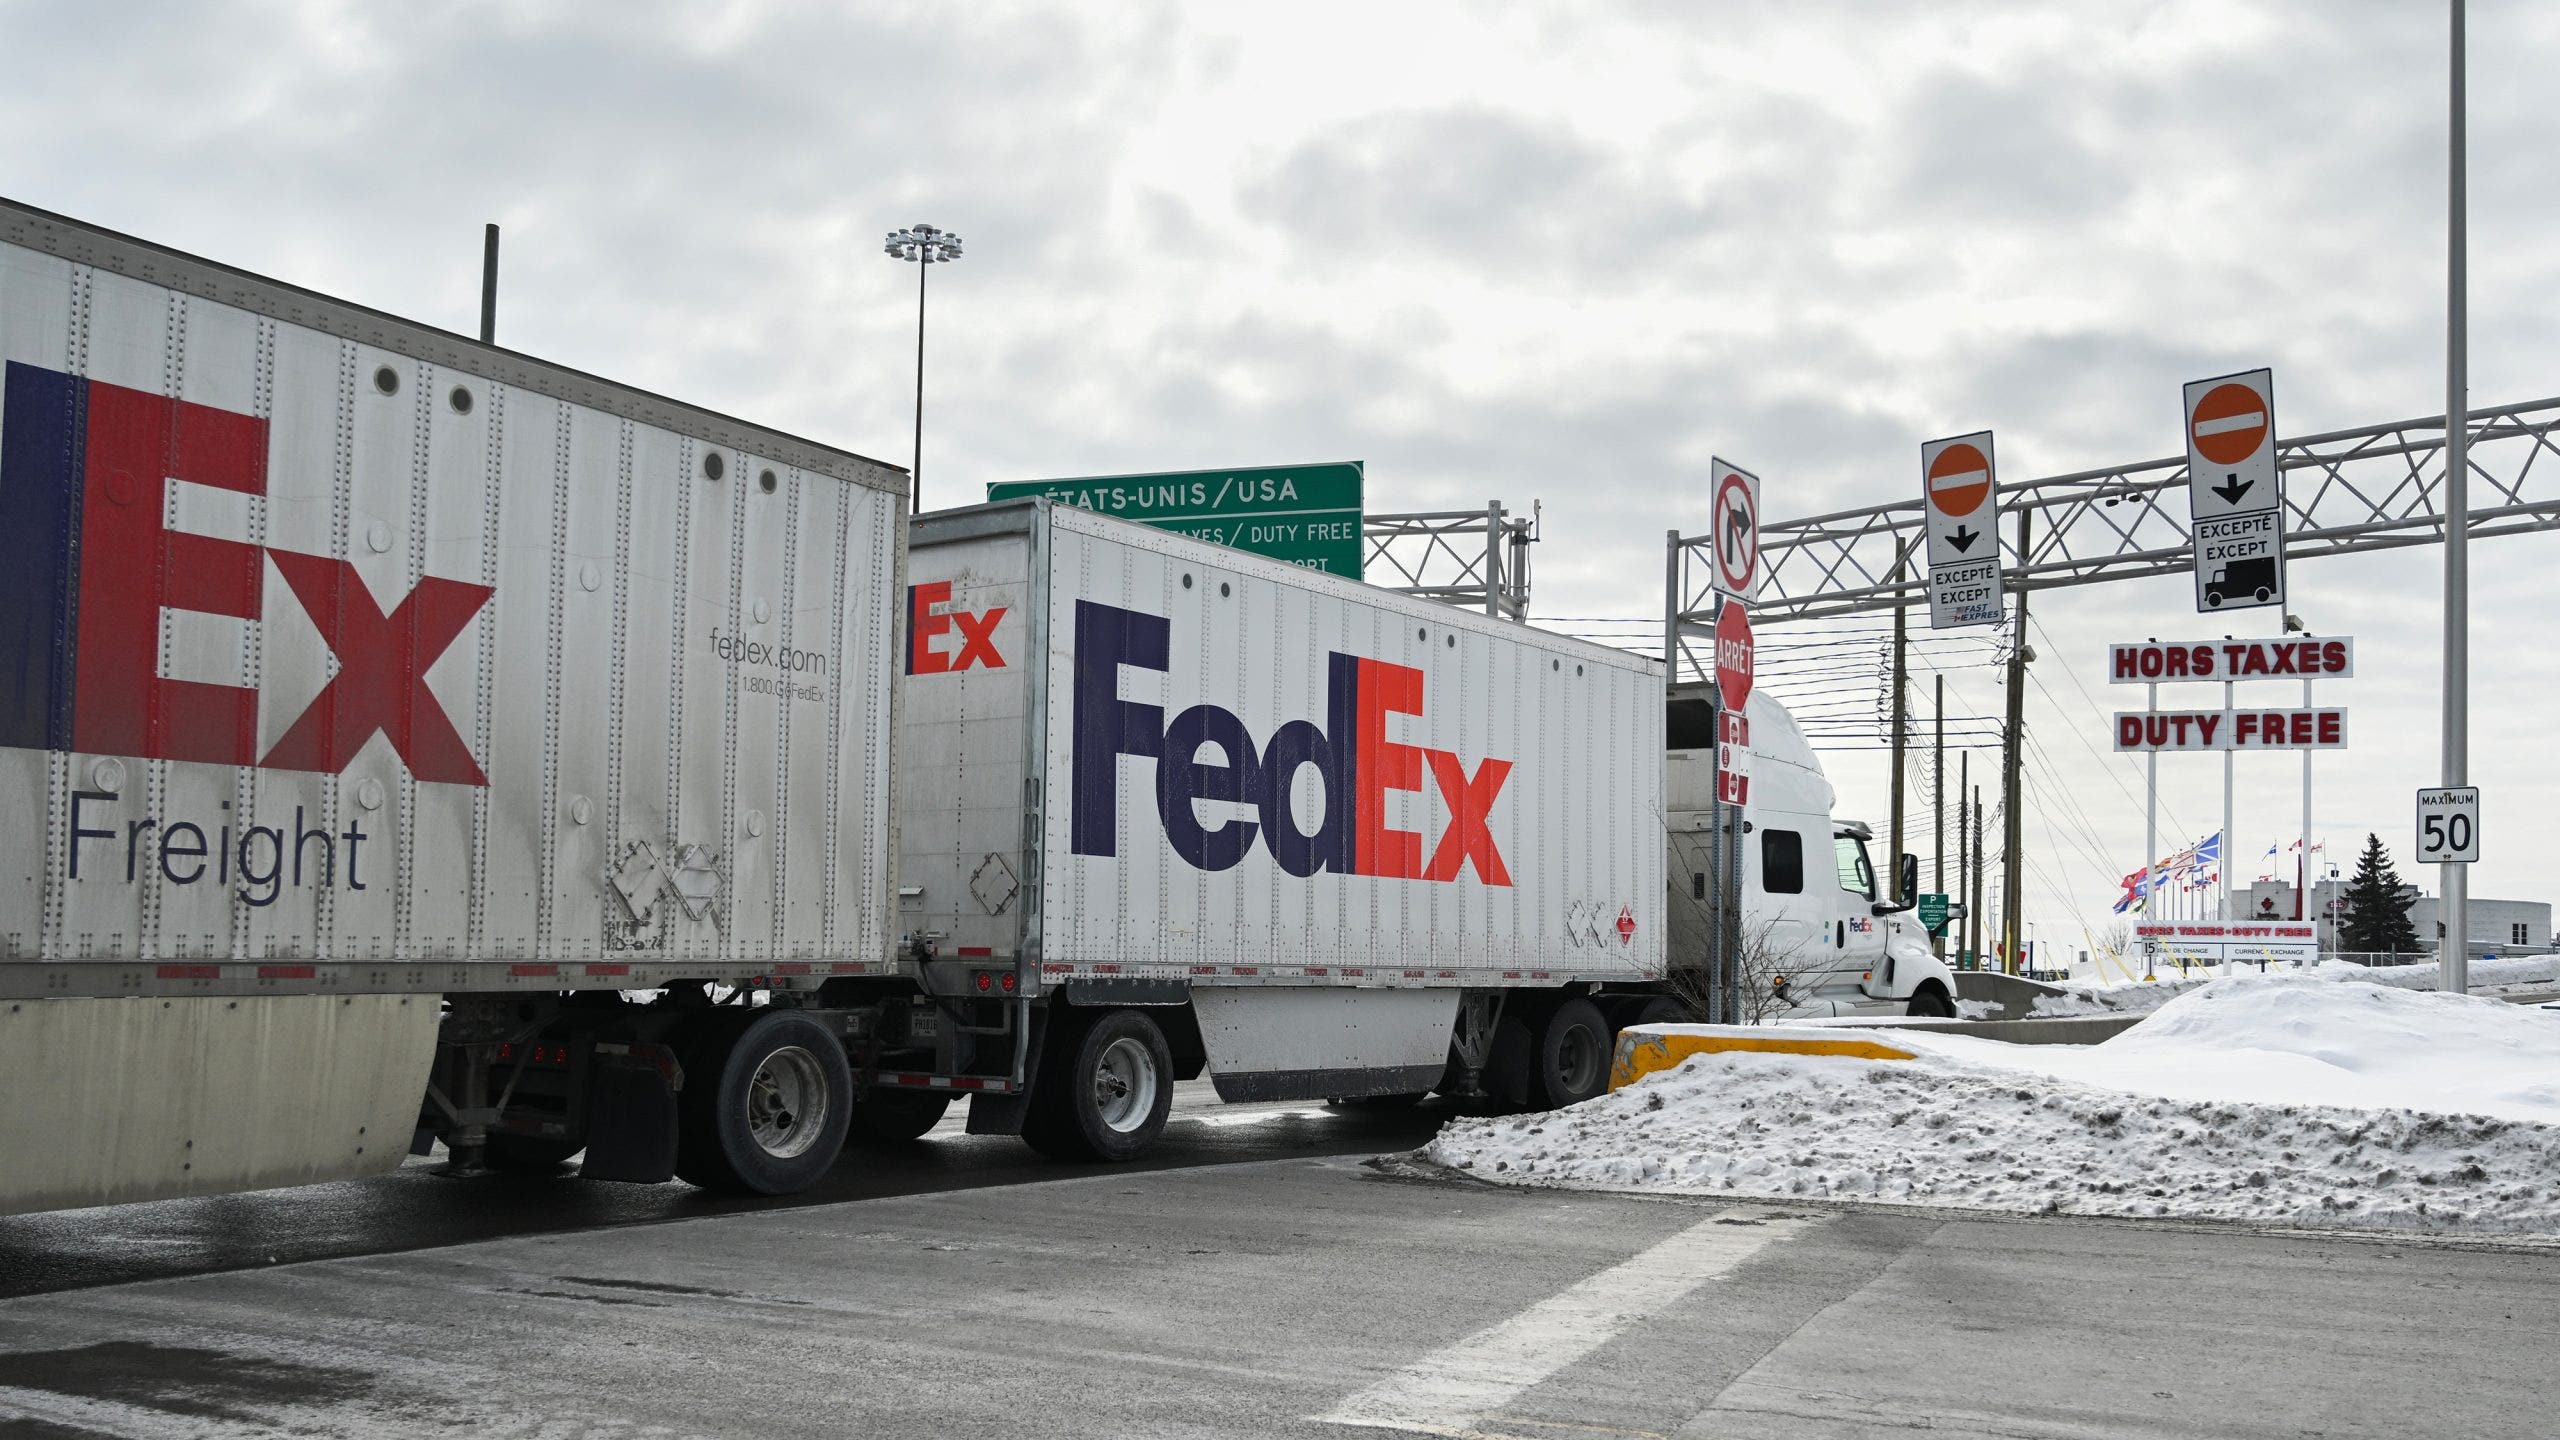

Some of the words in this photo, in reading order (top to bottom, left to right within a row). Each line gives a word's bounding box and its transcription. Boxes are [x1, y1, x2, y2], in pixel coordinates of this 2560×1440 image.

[1238, 478, 1299, 503] USA
[1173, 528, 1224, 544] XES
[1251, 524, 1299, 544] DUTY
[1307, 522, 1353, 542] FREE
[2200, 515, 2272, 539] EXCEPTÉ
[2206, 540, 2268, 560] EXCEPT
[1935, 564, 1994, 585] EXCEPTÉ
[1940, 587, 1991, 604] EXCEPT
[1964, 603, 1988, 613] FAST
[709, 626, 826, 675] fedex.com
[1717, 638, 1752, 676] ARRÊT
[2115, 645, 2214, 678] HORS
[2223, 641, 2346, 675] TAXES
[743, 676, 825, 702] 1.800.GoFedEx
[2120, 714, 2221, 747] DUTY
[2236, 712, 2340, 745] FREE
[1071, 598, 1514, 888] FedEx
[2422, 794, 2474, 806] MAXIMUM
[2424, 813, 2471, 852] 50
[68, 790, 369, 907] Freight
[1930, 895, 1937, 904] P
[1849, 917, 1873, 932] FedEx
[2137, 926, 2175, 936] HORS
[2178, 926, 2225, 936] TAXES
[2232, 927, 2271, 937] DUTY
[2275, 927, 2313, 937] FREE
[2144, 942, 2155, 954] 15
